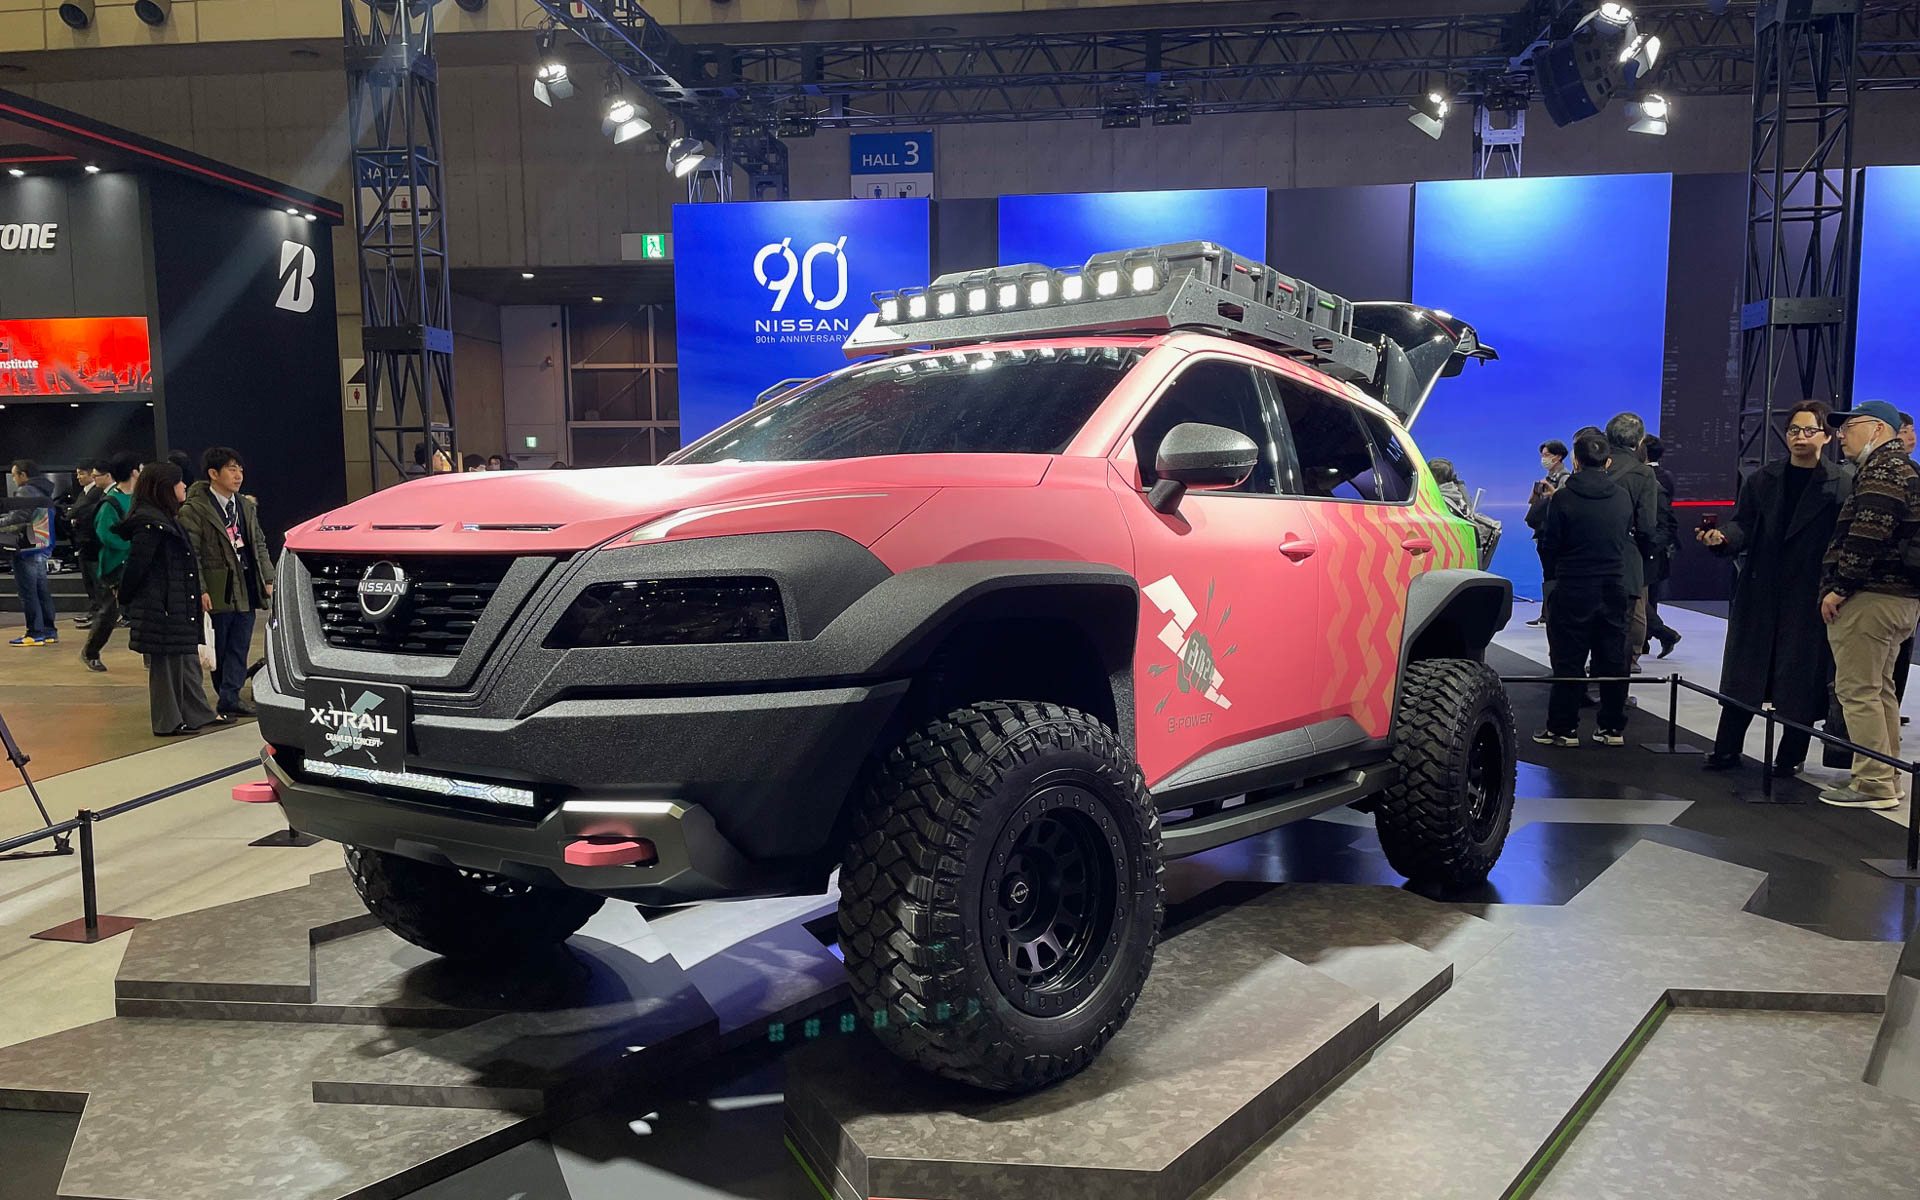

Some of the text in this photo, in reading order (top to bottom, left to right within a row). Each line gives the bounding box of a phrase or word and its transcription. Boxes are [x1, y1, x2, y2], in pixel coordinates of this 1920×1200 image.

[862, 140, 920, 167] HALL 3
[753, 235, 848, 312] 90
[755, 318, 849, 333] NISSAN
[755, 334, 848, 344] 90th ANNIVERSARY
[358, 581, 405, 594] NISSAN
[310, 707, 398, 735] X-TRAIL
[353, 736, 381, 748] CONCEPT
